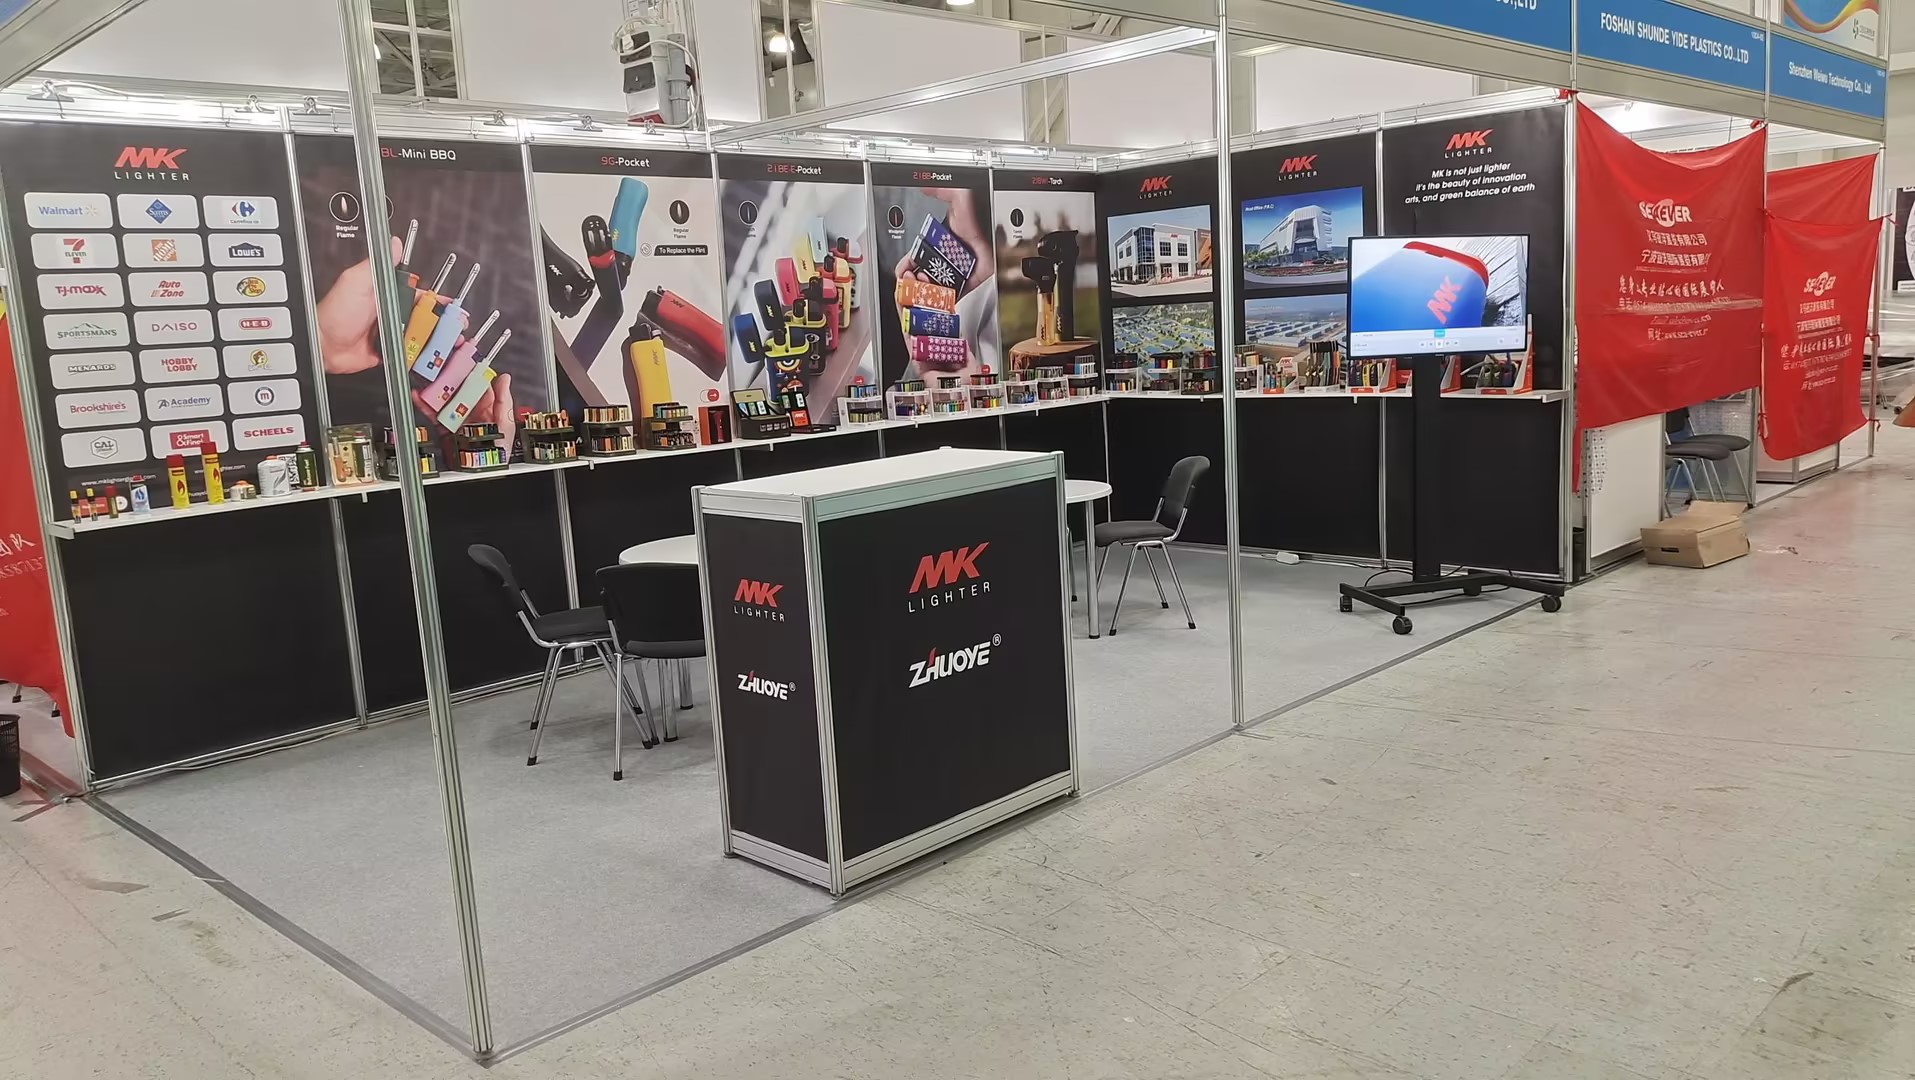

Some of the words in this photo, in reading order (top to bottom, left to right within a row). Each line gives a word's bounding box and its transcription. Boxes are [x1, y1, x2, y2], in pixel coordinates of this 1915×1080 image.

[1600, 12, 1635, 36] FOSHAN
[1637, 21, 1670, 45] SHUNDE
[1671, 30, 1688, 49] YIDE
[1690, 37, 1722, 58] PLASTICS
[1788, 61, 1813, 80] Shenzhen
[1828, 72, 1854, 93] Technology
[1445, 128, 1495, 151] MK
[114, 146, 188, 169] MK
[429, 149, 457, 161] BBQ
[1444, 146, 1493, 159] LIGHTER
[601, 156, 650, 168] 9G-Pocket
[1279, 154, 1318, 174] MK
[114, 171, 190, 181] LIGHTER
[1278, 170, 1318, 182] LIGHTER
[1431, 168, 1444, 179] MK
[1445, 169, 1452, 177] is
[1453, 166, 1467, 176] not
[1467, 164, 1482, 176] just
[1483, 162, 1511, 174] lighter
[1140, 175, 1173, 193] MK
[1427, 181, 1440, 190] the
[1442, 177, 1471, 189] beauty
[1472, 176, 1481, 185] of
[1482, 172, 1527, 184] innovation
[1139, 189, 1174, 201] LIGHTER
[1404, 194, 1421, 204] arts,
[1422, 192, 1438, 202] and
[1440, 191, 1463, 203] green
[1464, 187, 1500, 199] balance
[1501, 185, 1511, 194] of
[1512, 182, 1536, 194] earth
[38, 205, 84, 215] Walmart
[336, 231, 356, 239] Flame
[667, 247, 687, 255] Replace
[158, 280, 181, 289] Auto
[160, 289, 184, 298] Zone
[1426, 275, 1462, 325] MK
[151, 322, 198, 332] DAISO
[161, 357, 194, 366] HOBBY
[167, 363, 198, 373] LOBBY
[170, 397, 212, 406] Academy
[243, 426, 294, 438] SCHEELS
[94, 440, 115, 449] CAL
[909, 541, 990, 594] MK
[734, 578, 784, 608] MK
[908, 581, 992, 613] LIGHTER
[733, 605, 786, 623] LIGHTER
[908, 641, 991, 689] ZHUOYE
[737, 670, 789, 701] ZHUOYE
